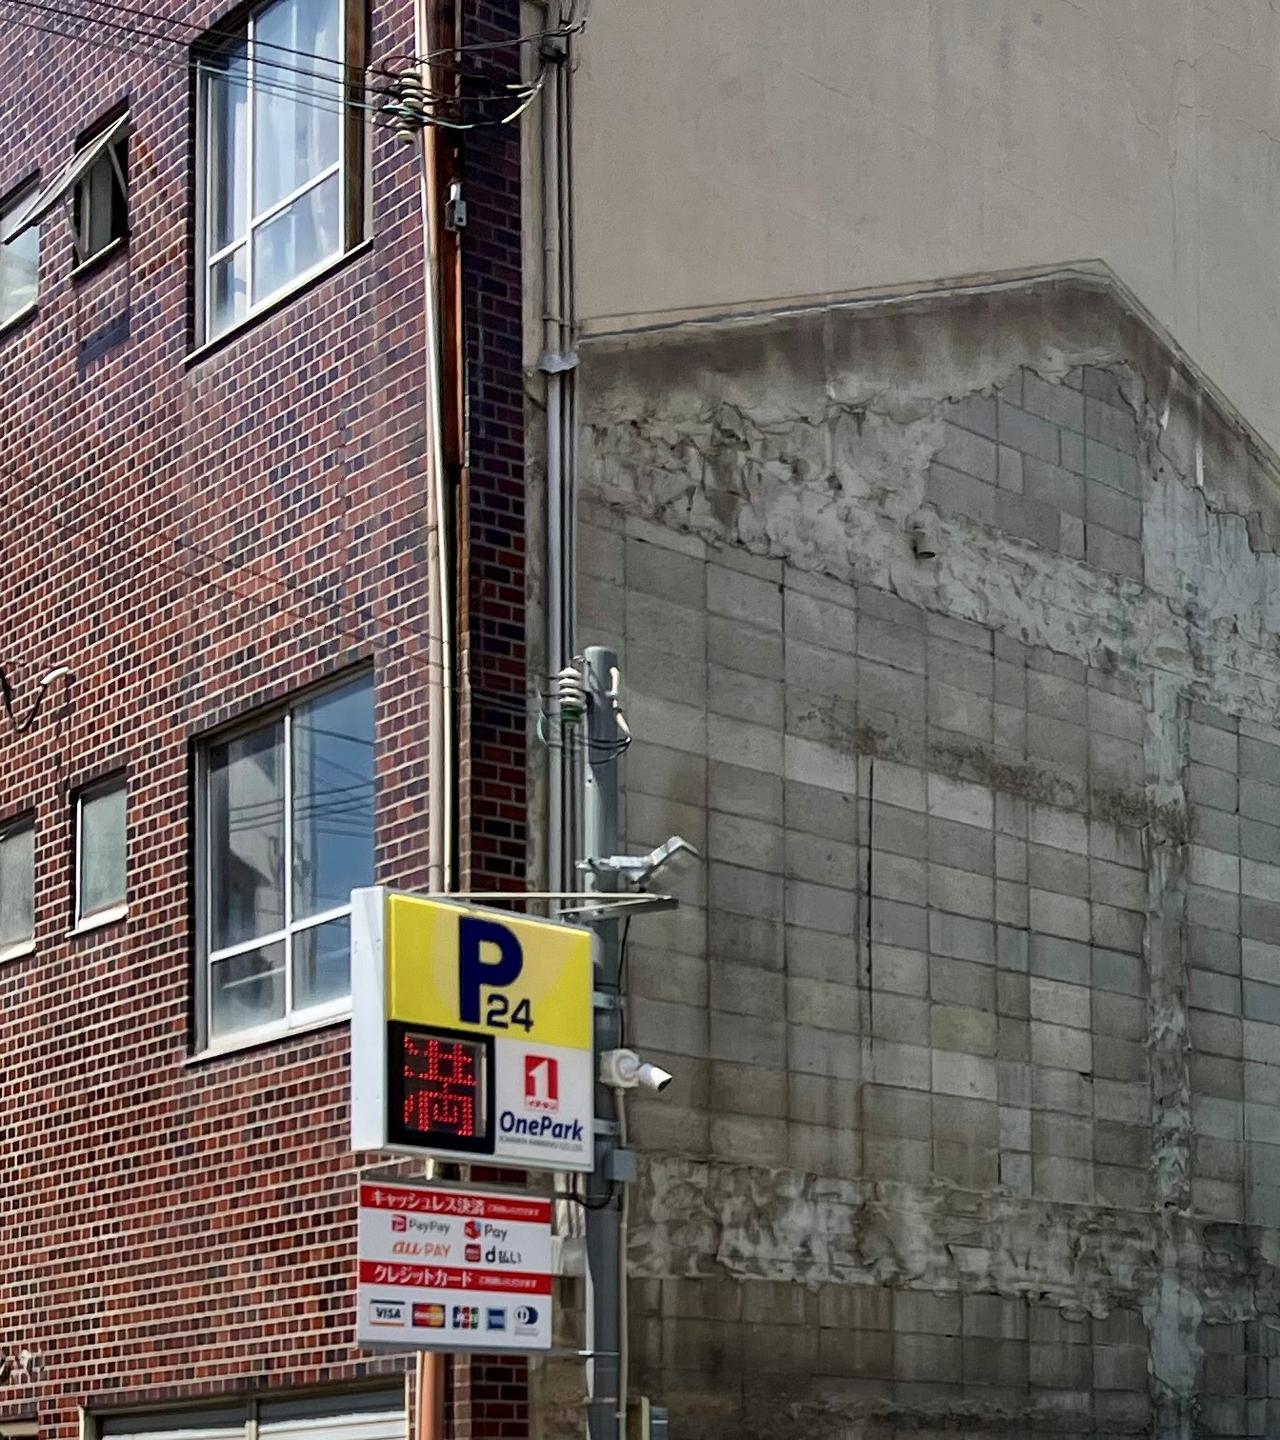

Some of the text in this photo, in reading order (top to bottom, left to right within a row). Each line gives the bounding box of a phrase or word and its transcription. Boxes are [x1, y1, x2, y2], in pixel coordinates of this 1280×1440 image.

[459, 916, 534, 1033] P 24
[404, 1034, 477, 1137] 満
[500, 1110, 584, 1141] OnePark
[373, 1189, 485, 1216] キャッシュレス決済
[409, 1216, 450, 1234] PayPay
[484, 1224, 508, 1242] Pay
[424, 1243, 450, 1258] PAY
[373, 1264, 472, 1288] クレジットカード
[376, 1306, 402, 1319] VISA
